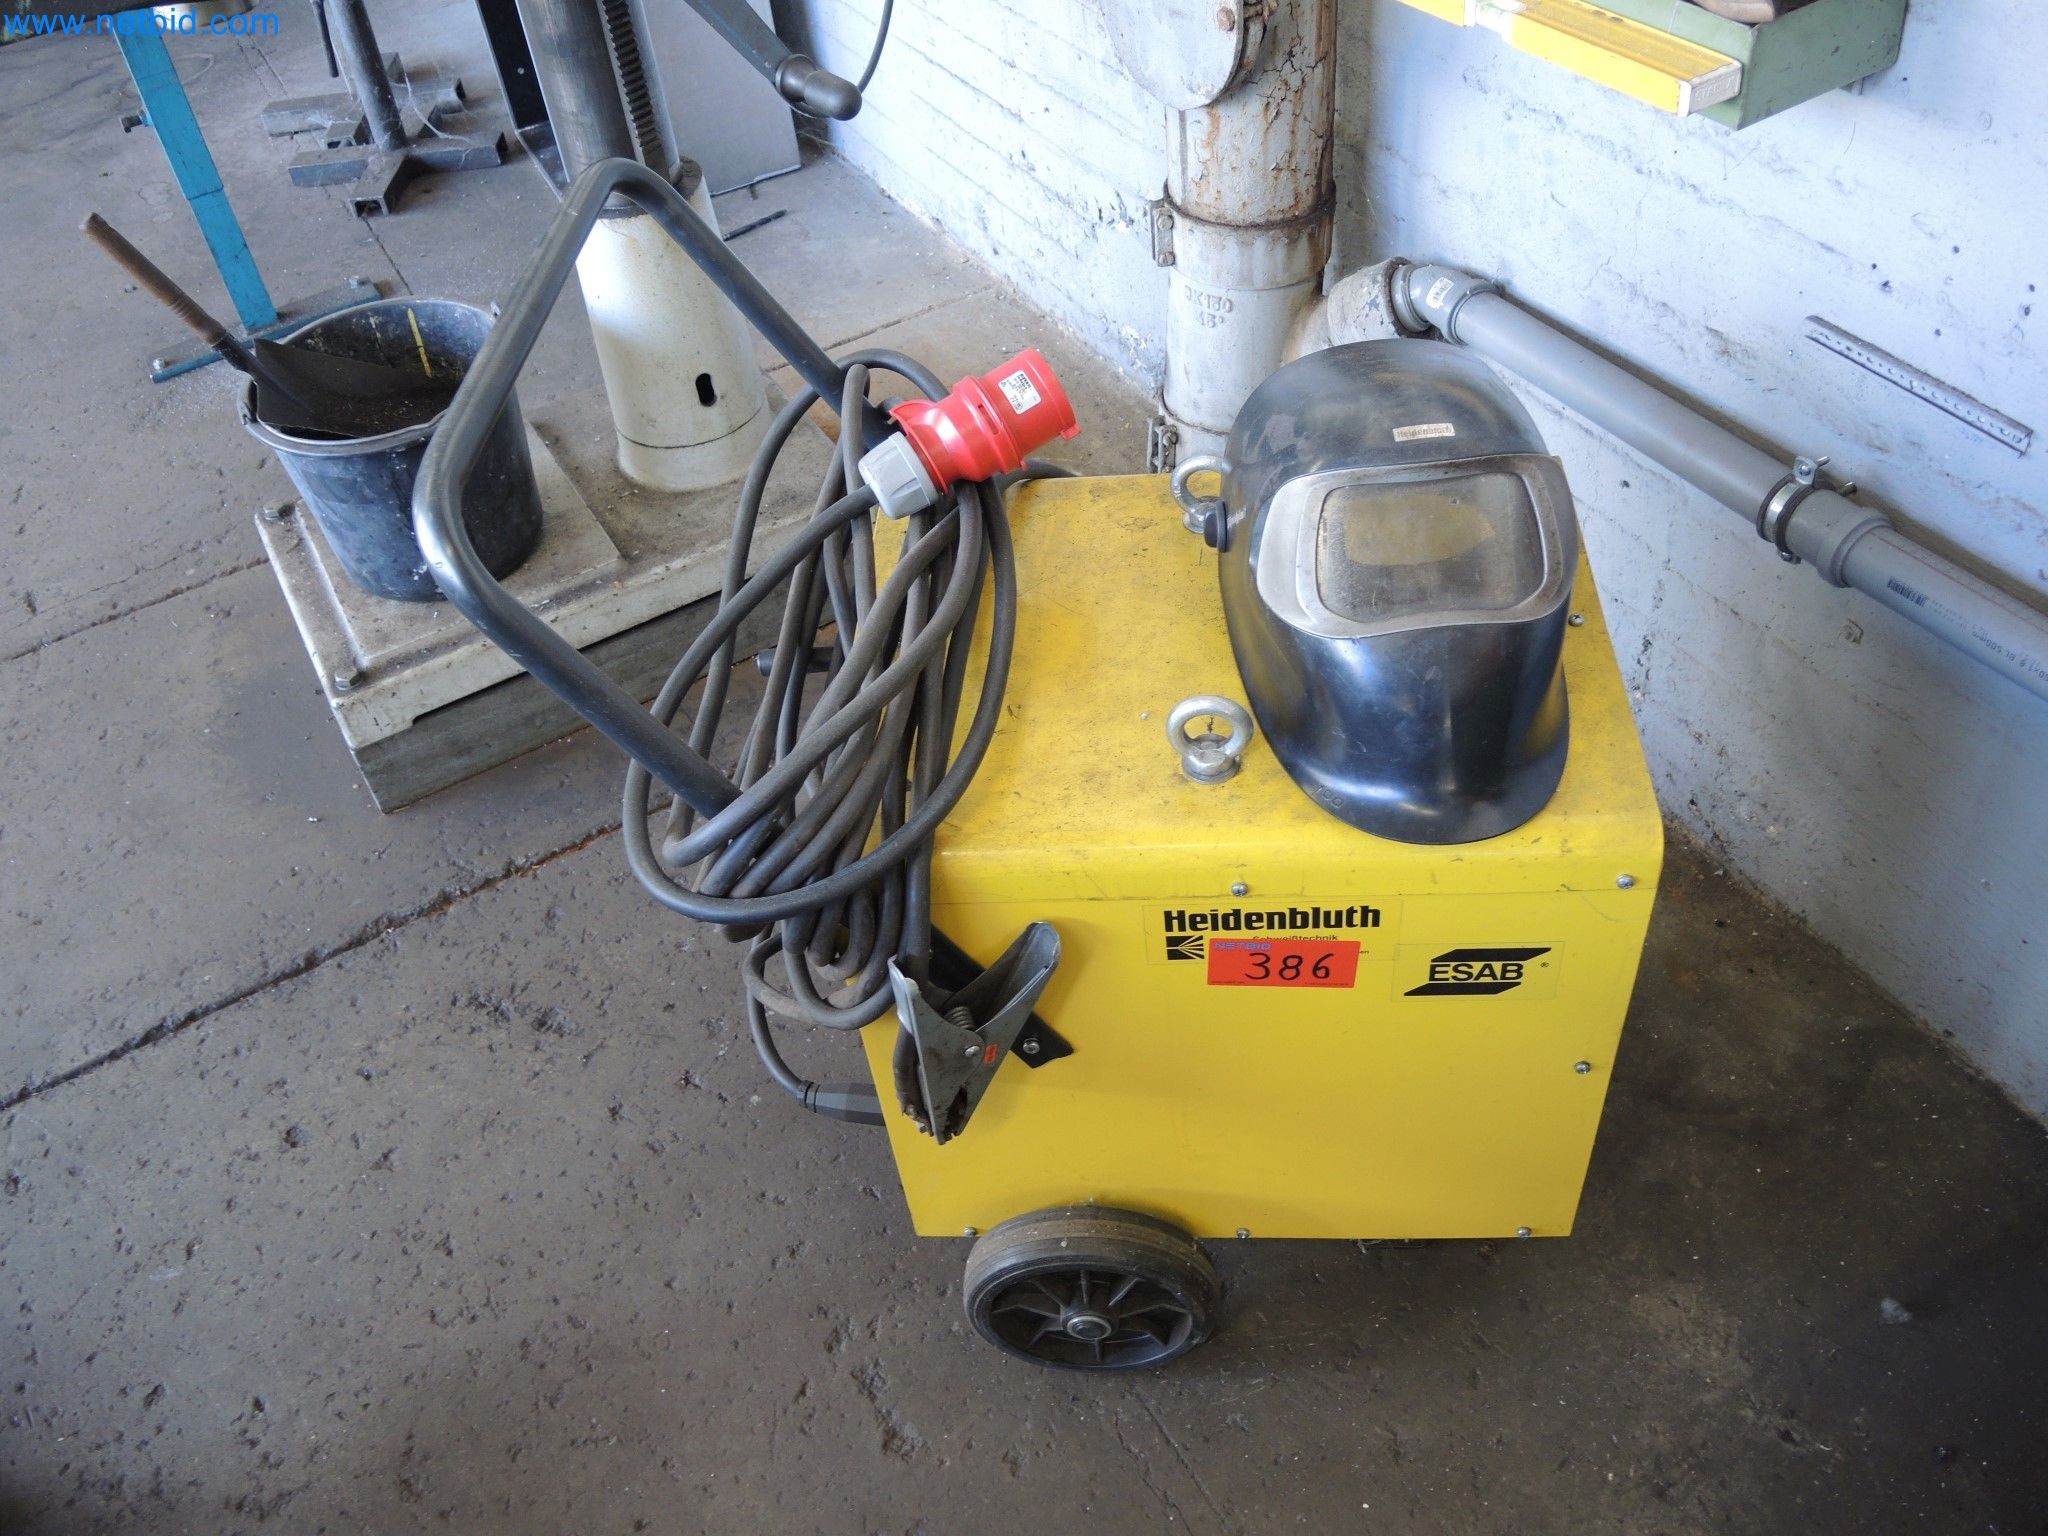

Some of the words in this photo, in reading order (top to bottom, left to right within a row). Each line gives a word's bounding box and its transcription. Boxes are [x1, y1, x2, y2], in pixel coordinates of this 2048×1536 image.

[1163, 905, 1381, 933] Heidenbluth
[1244, 952, 1335, 981] 386
[1428, 962, 1524, 982] ESAB
